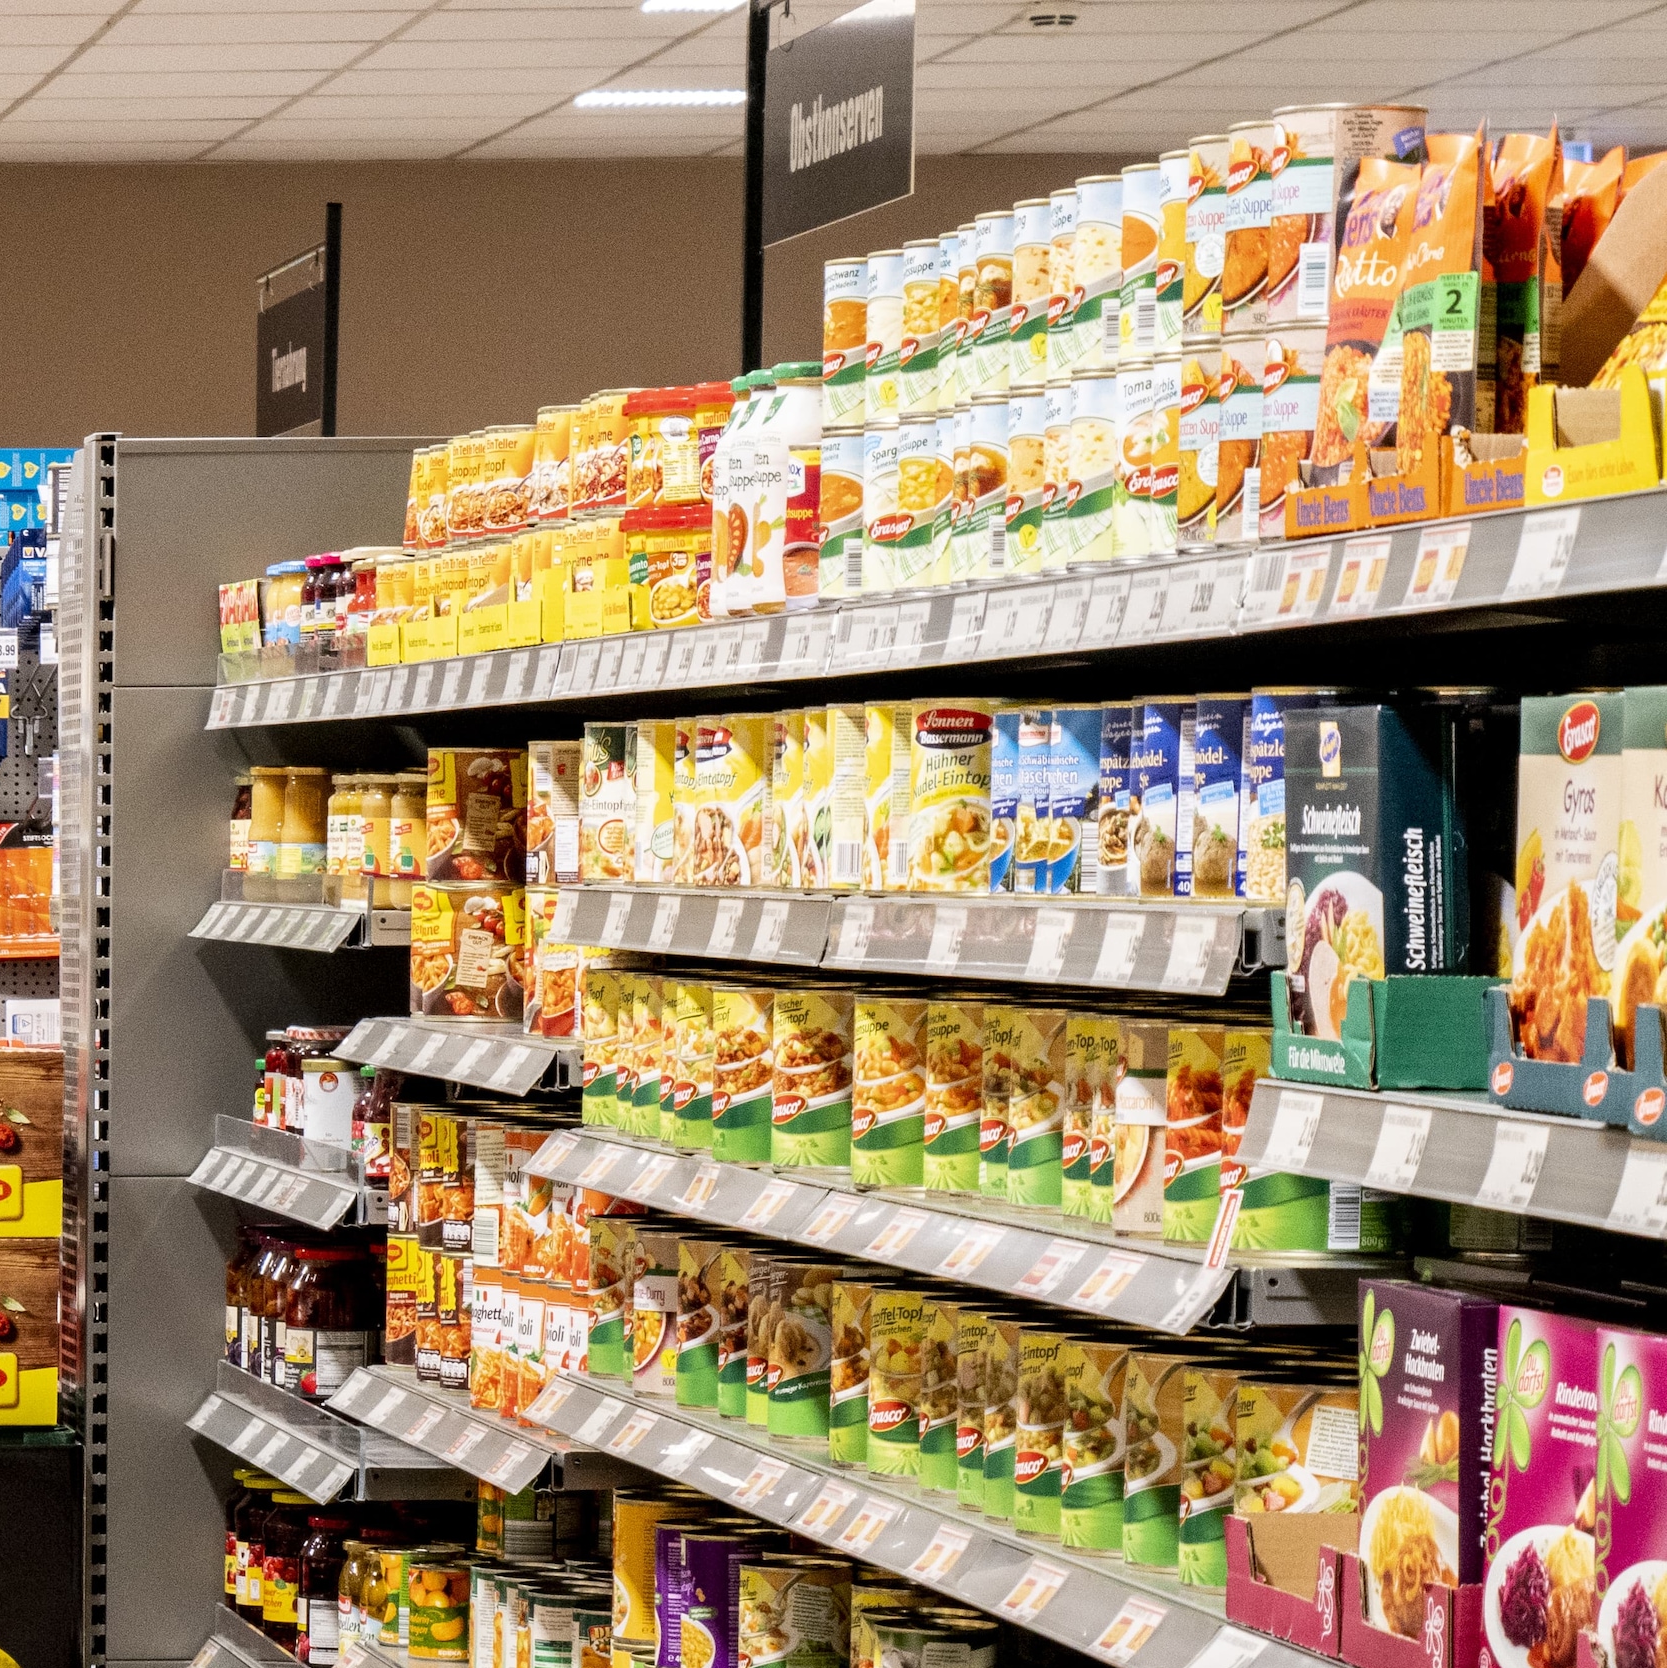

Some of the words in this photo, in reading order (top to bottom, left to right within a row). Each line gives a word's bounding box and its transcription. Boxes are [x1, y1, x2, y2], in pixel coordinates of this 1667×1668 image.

[790, 84, 884, 173] Obstkonserven
[1445, 289, 1464, 315] 2
[1123, 378, 1153, 398] Toma
[924, 711, 974, 728] Sonnen
[920, 730, 983, 745] Bassermann
[1563, 708, 1596, 758] Erasco
[926, 752, 975, 773] Hühner
[913, 769, 990, 799] Nudel-Eintop
[1564, 780, 1597, 822] Gyros
[1302, 804, 1360, 840] Schweinefleisch
[1403, 827, 1428, 971] Schweinefleisch
[1288, 1046, 1300, 1068] Für
[1301, 1047, 1310, 1069] die
[1410, 1329, 1440, 1355] Zwiebel-
[1405, 1355, 1445, 1381] Hackbraten
[1555, 1382, 1597, 1410] Rinderrou
